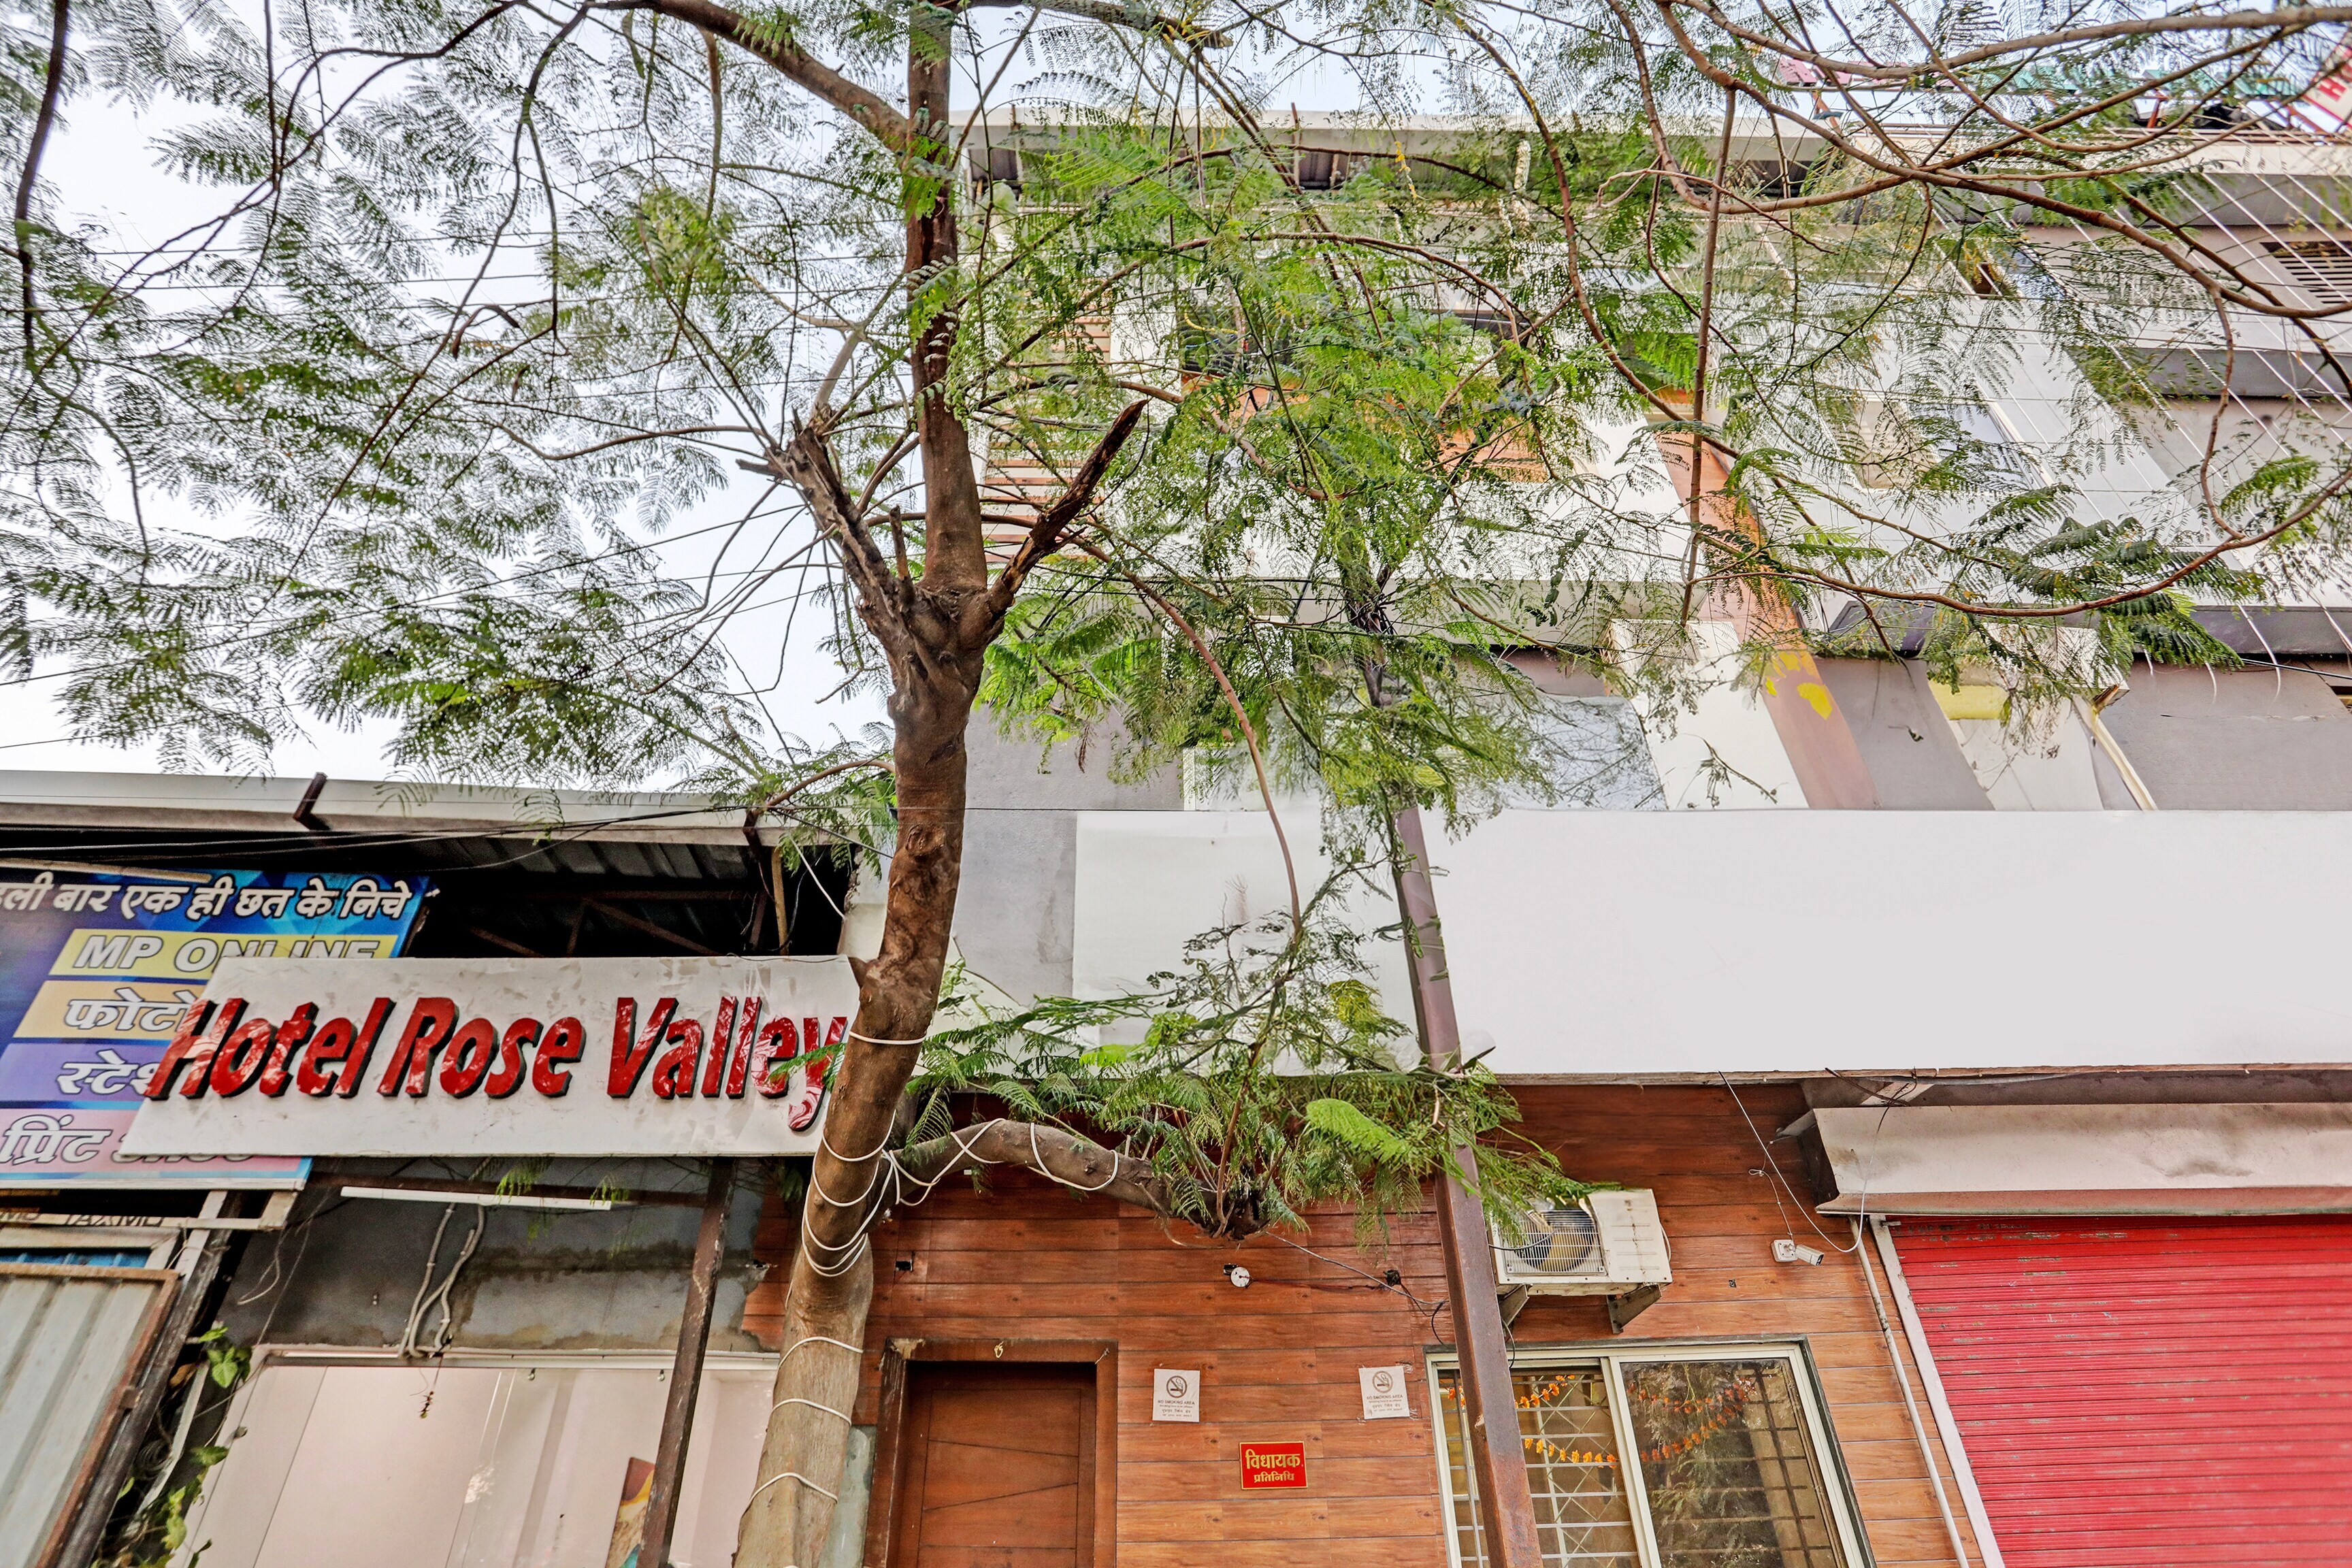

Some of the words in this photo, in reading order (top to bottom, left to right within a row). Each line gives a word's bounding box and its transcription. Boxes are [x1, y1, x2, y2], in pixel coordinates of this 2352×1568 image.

[0, 871, 54, 911] ली
[53, 884, 122, 913] बार
[120, 885, 190, 920] एक
[186, 875, 234, 921] ही
[234, 887, 295, 918] छत
[295, 877, 340, 918] के
[339, 879, 413, 919] निचे
[73, 934, 163, 970] MP
[144, 996, 397, 1100] Hotel
[376, 996, 587, 1100] Rose
[606, 996, 849, 1132] Valley
[1245, 1448, 1301, 1469] विधायक
[1254, 1470, 1294, 1484] प्रतिनिधि
